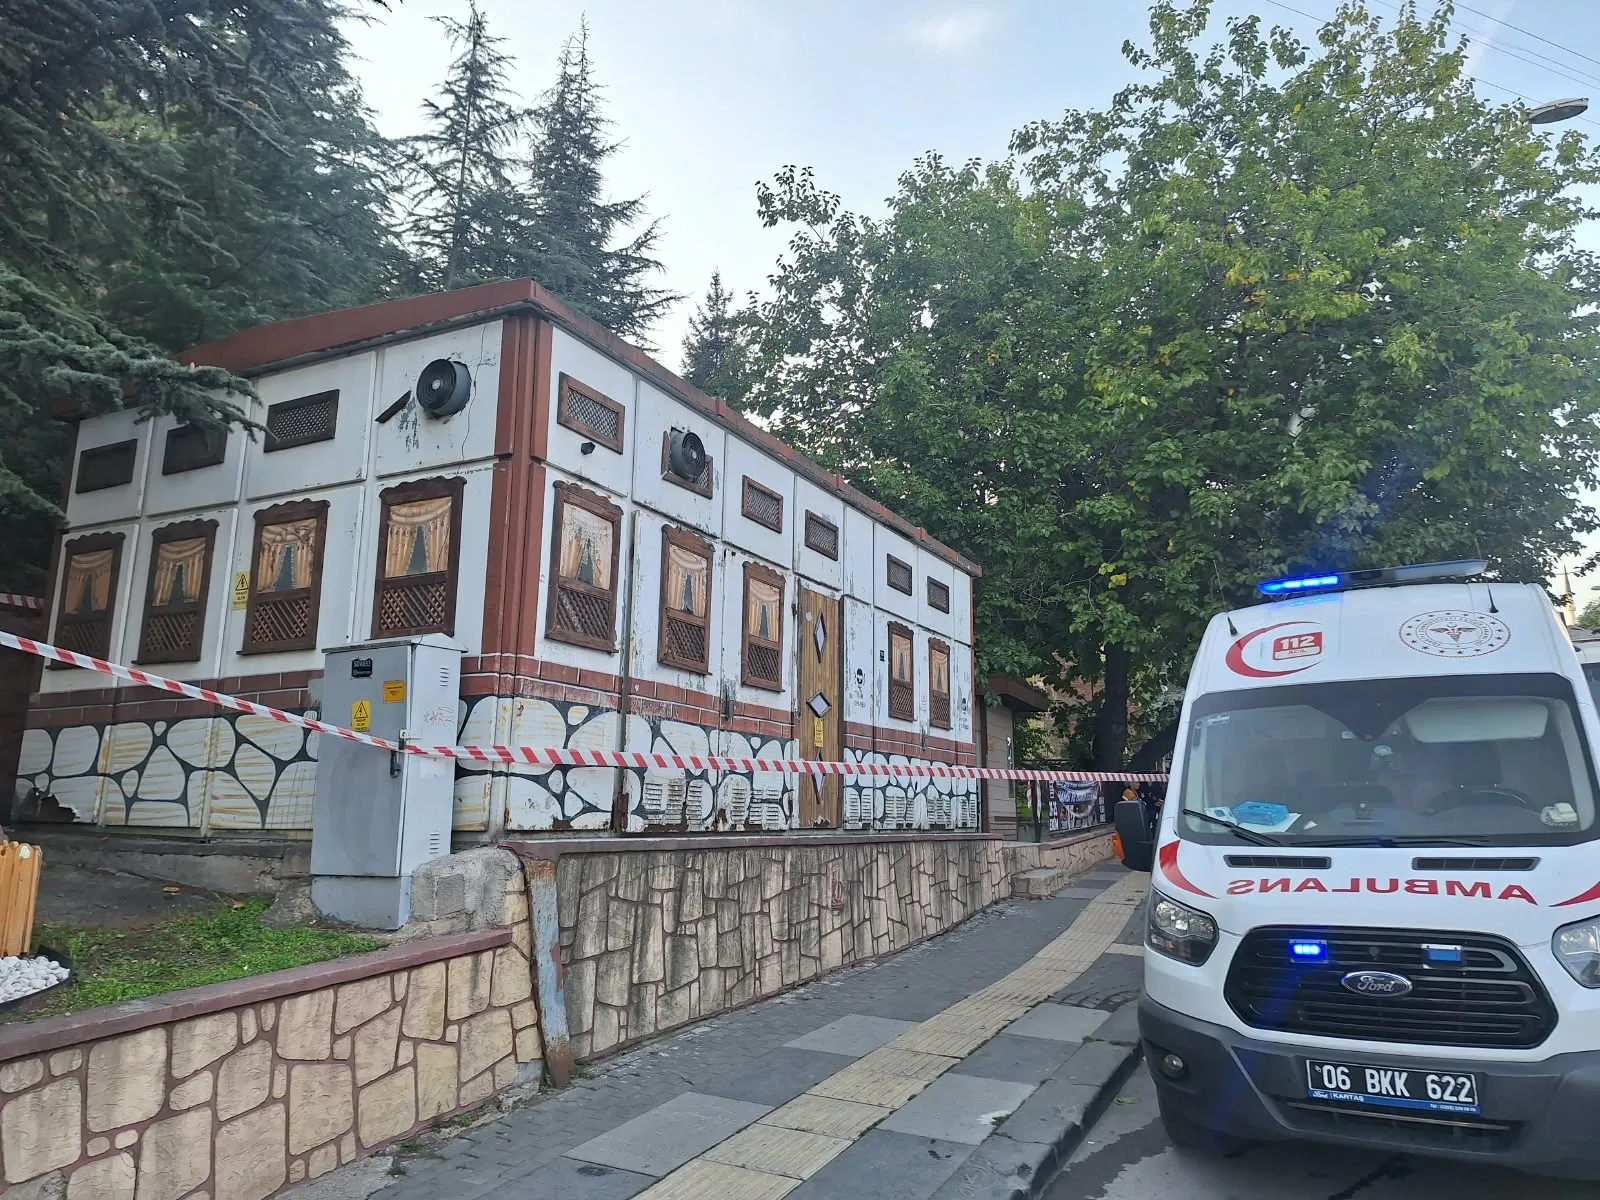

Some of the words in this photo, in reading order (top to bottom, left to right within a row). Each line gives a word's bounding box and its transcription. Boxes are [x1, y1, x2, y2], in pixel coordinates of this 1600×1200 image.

[1280, 636, 1315, 650] 112
[1357, 975, 1396, 992] Ford
[1322, 1064, 1351, 1091] 06
[1365, 1068, 1410, 1097] BKK
[1425, 1074, 1474, 1103] 622
